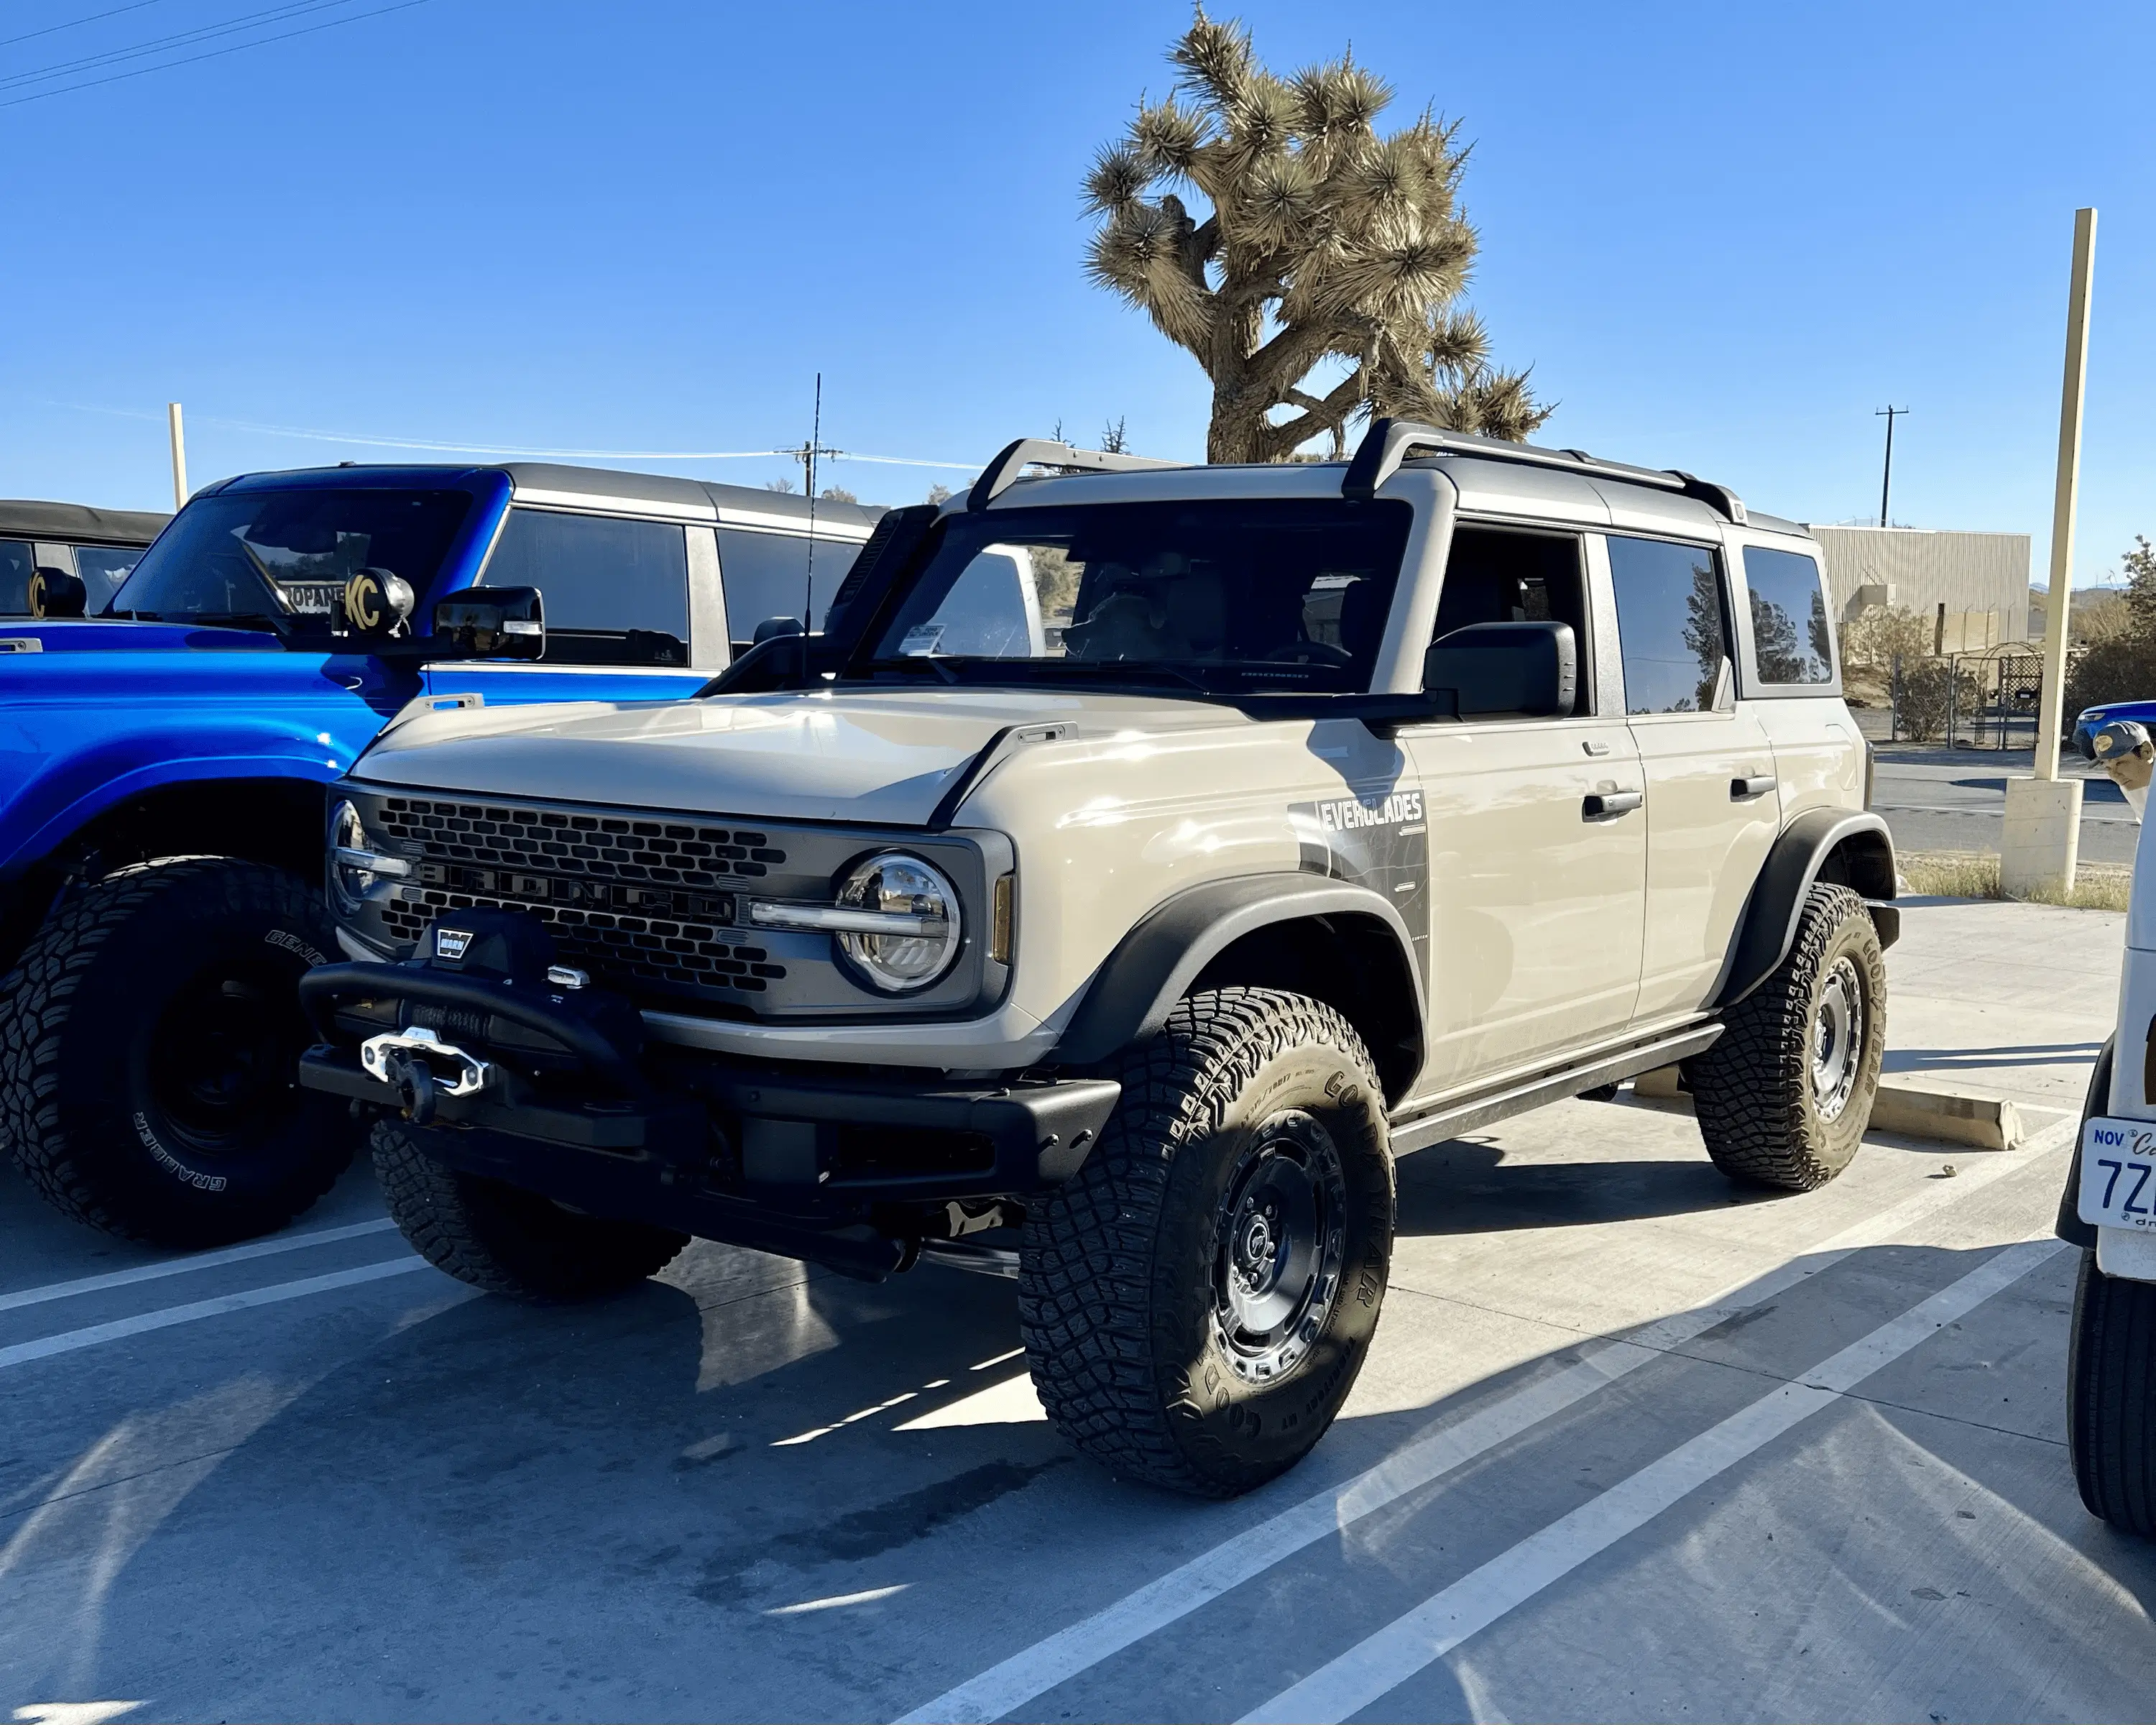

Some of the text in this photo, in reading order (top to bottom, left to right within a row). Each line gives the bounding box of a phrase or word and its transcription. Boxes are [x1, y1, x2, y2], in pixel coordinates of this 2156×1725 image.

[285, 587, 344, 607] ROPANE
[345, 574, 379, 630] KC
[1320, 793, 1422, 832] EVERGLADES
[417, 863, 734, 919] BRONCO
[264, 929, 327, 967] GENE
[441, 938, 465, 950] WARN
[132, 1111, 227, 1192] GRABBER
[2094, 1129, 2124, 1146] NOV
[2098, 1159, 2156, 1215] 7Z
